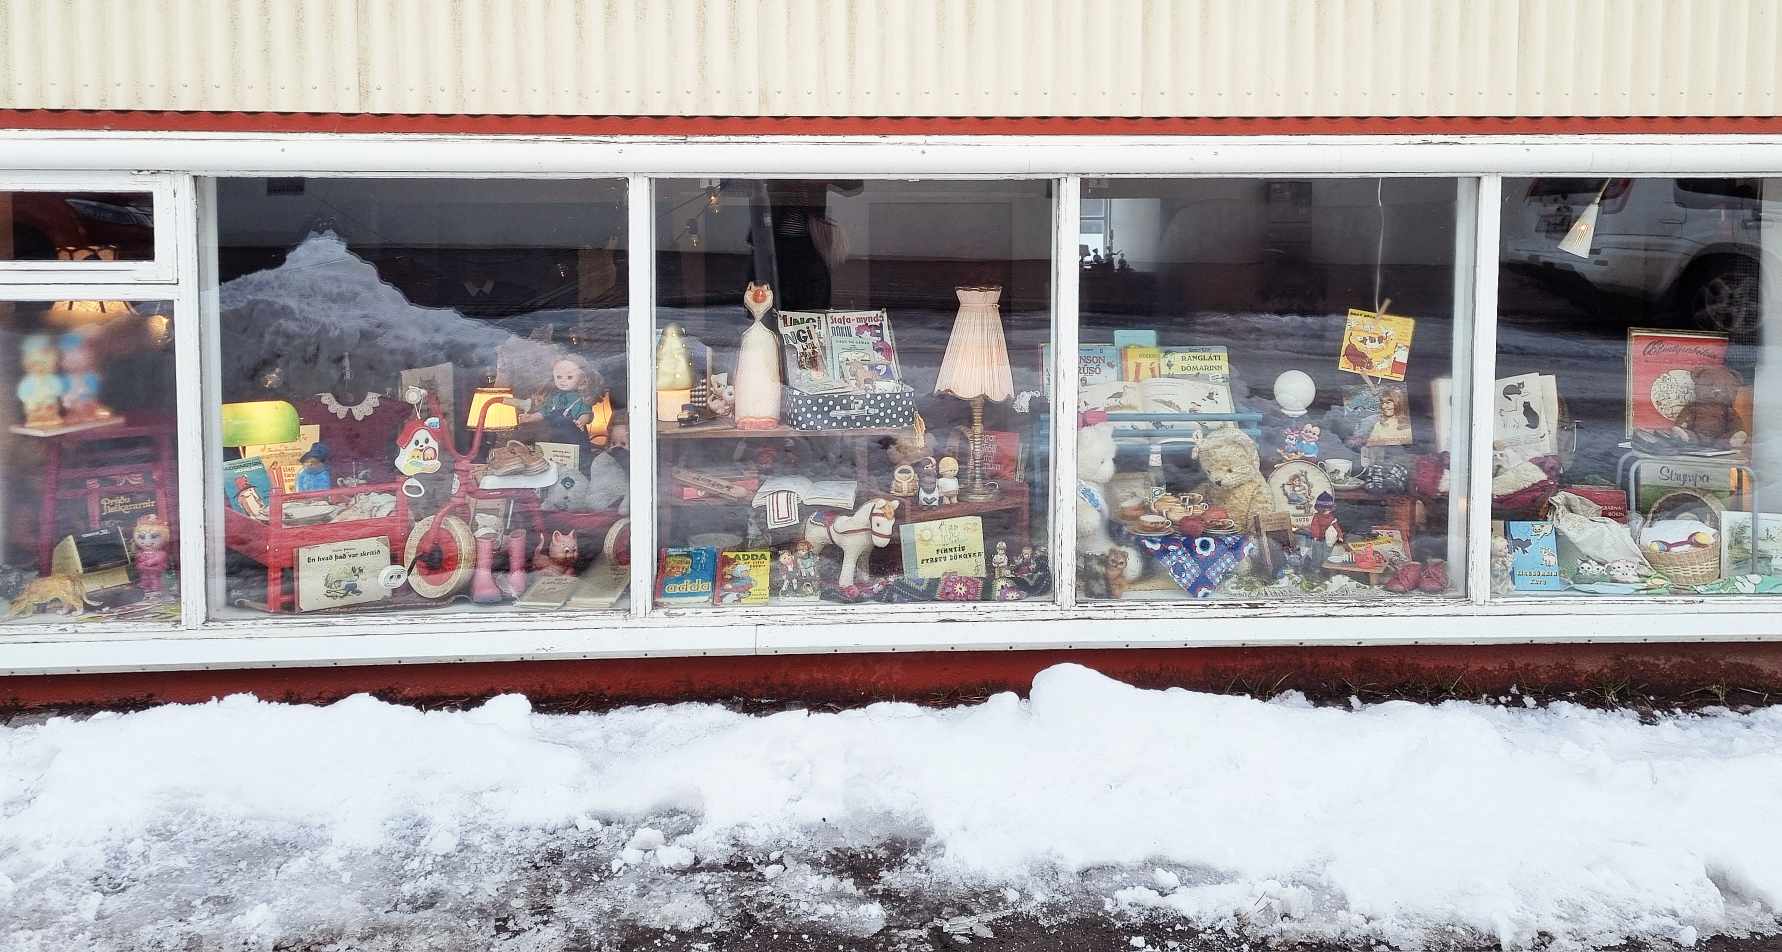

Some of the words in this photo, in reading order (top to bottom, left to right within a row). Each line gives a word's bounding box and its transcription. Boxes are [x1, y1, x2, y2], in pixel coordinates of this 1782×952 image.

[1078, 355, 1105, 364] NSON
[1180, 353, 1221, 361] RANGLÁTI
[1077, 364, 1102, 376] RÚSÓ
[1180, 363, 1223, 371] DÓMARINN
[307, 556, 316, 564] En
[334, 552, 347, 562] það
[734, 553, 768, 561] ADDA
[665, 579, 712, 594] adda
